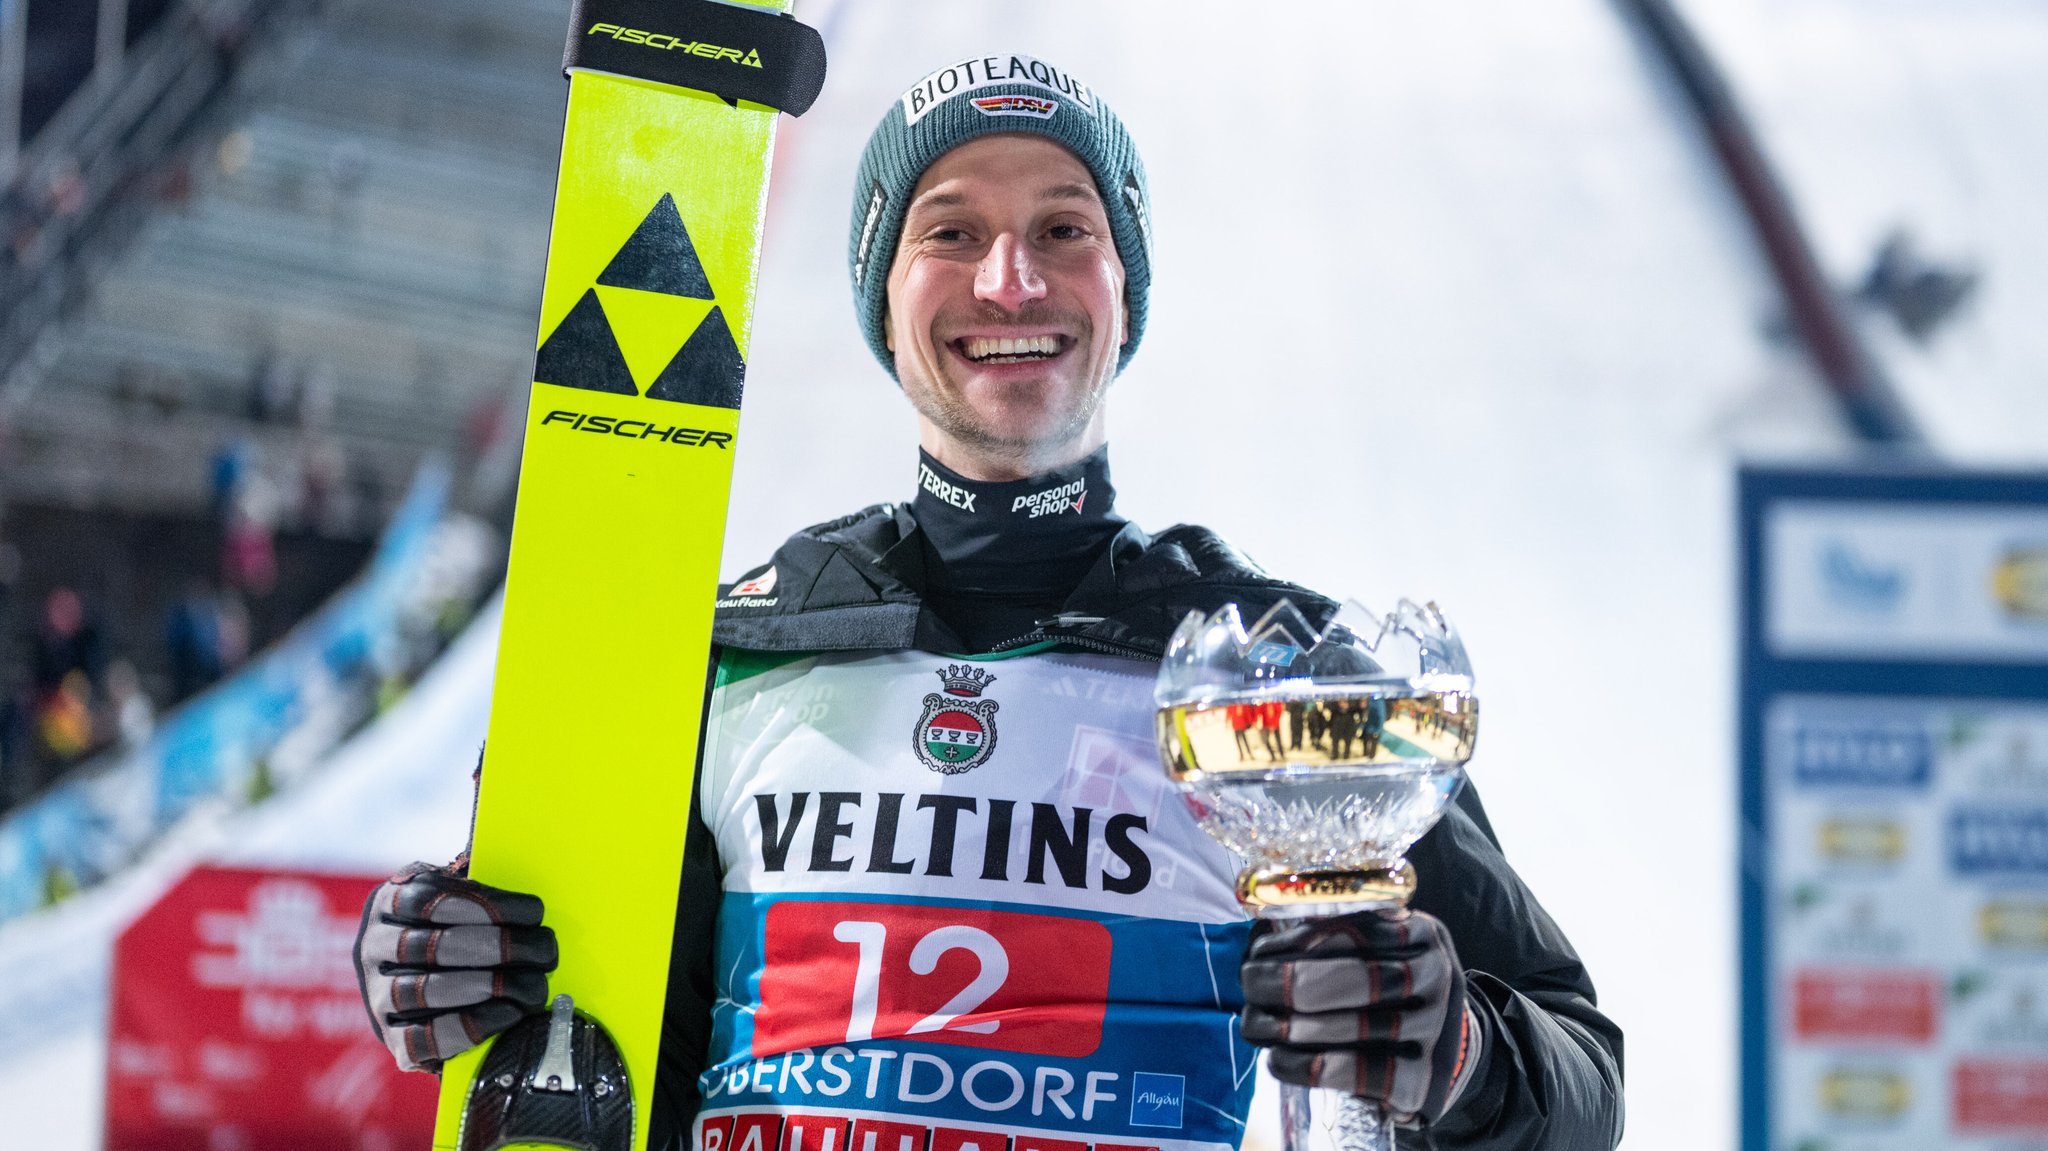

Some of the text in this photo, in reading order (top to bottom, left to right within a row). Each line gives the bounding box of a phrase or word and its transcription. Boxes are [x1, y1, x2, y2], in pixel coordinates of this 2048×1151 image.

[587, 22, 744, 65] FISCHER
[909, 55, 1092, 115] BIOTEAQUE
[1010, 97, 1054, 115] DSV
[858, 188, 882, 262] TERREX
[541, 410, 733, 449] FISCHER
[918, 462, 977, 513] TERREX
[1011, 477, 1085, 512] personal
[1029, 497, 1070, 518] shop
[754, 790, 1152, 895] VELTINS
[833, 920, 1010, 1042] 12
[1137, 1091, 1180, 1111] Allgäu
